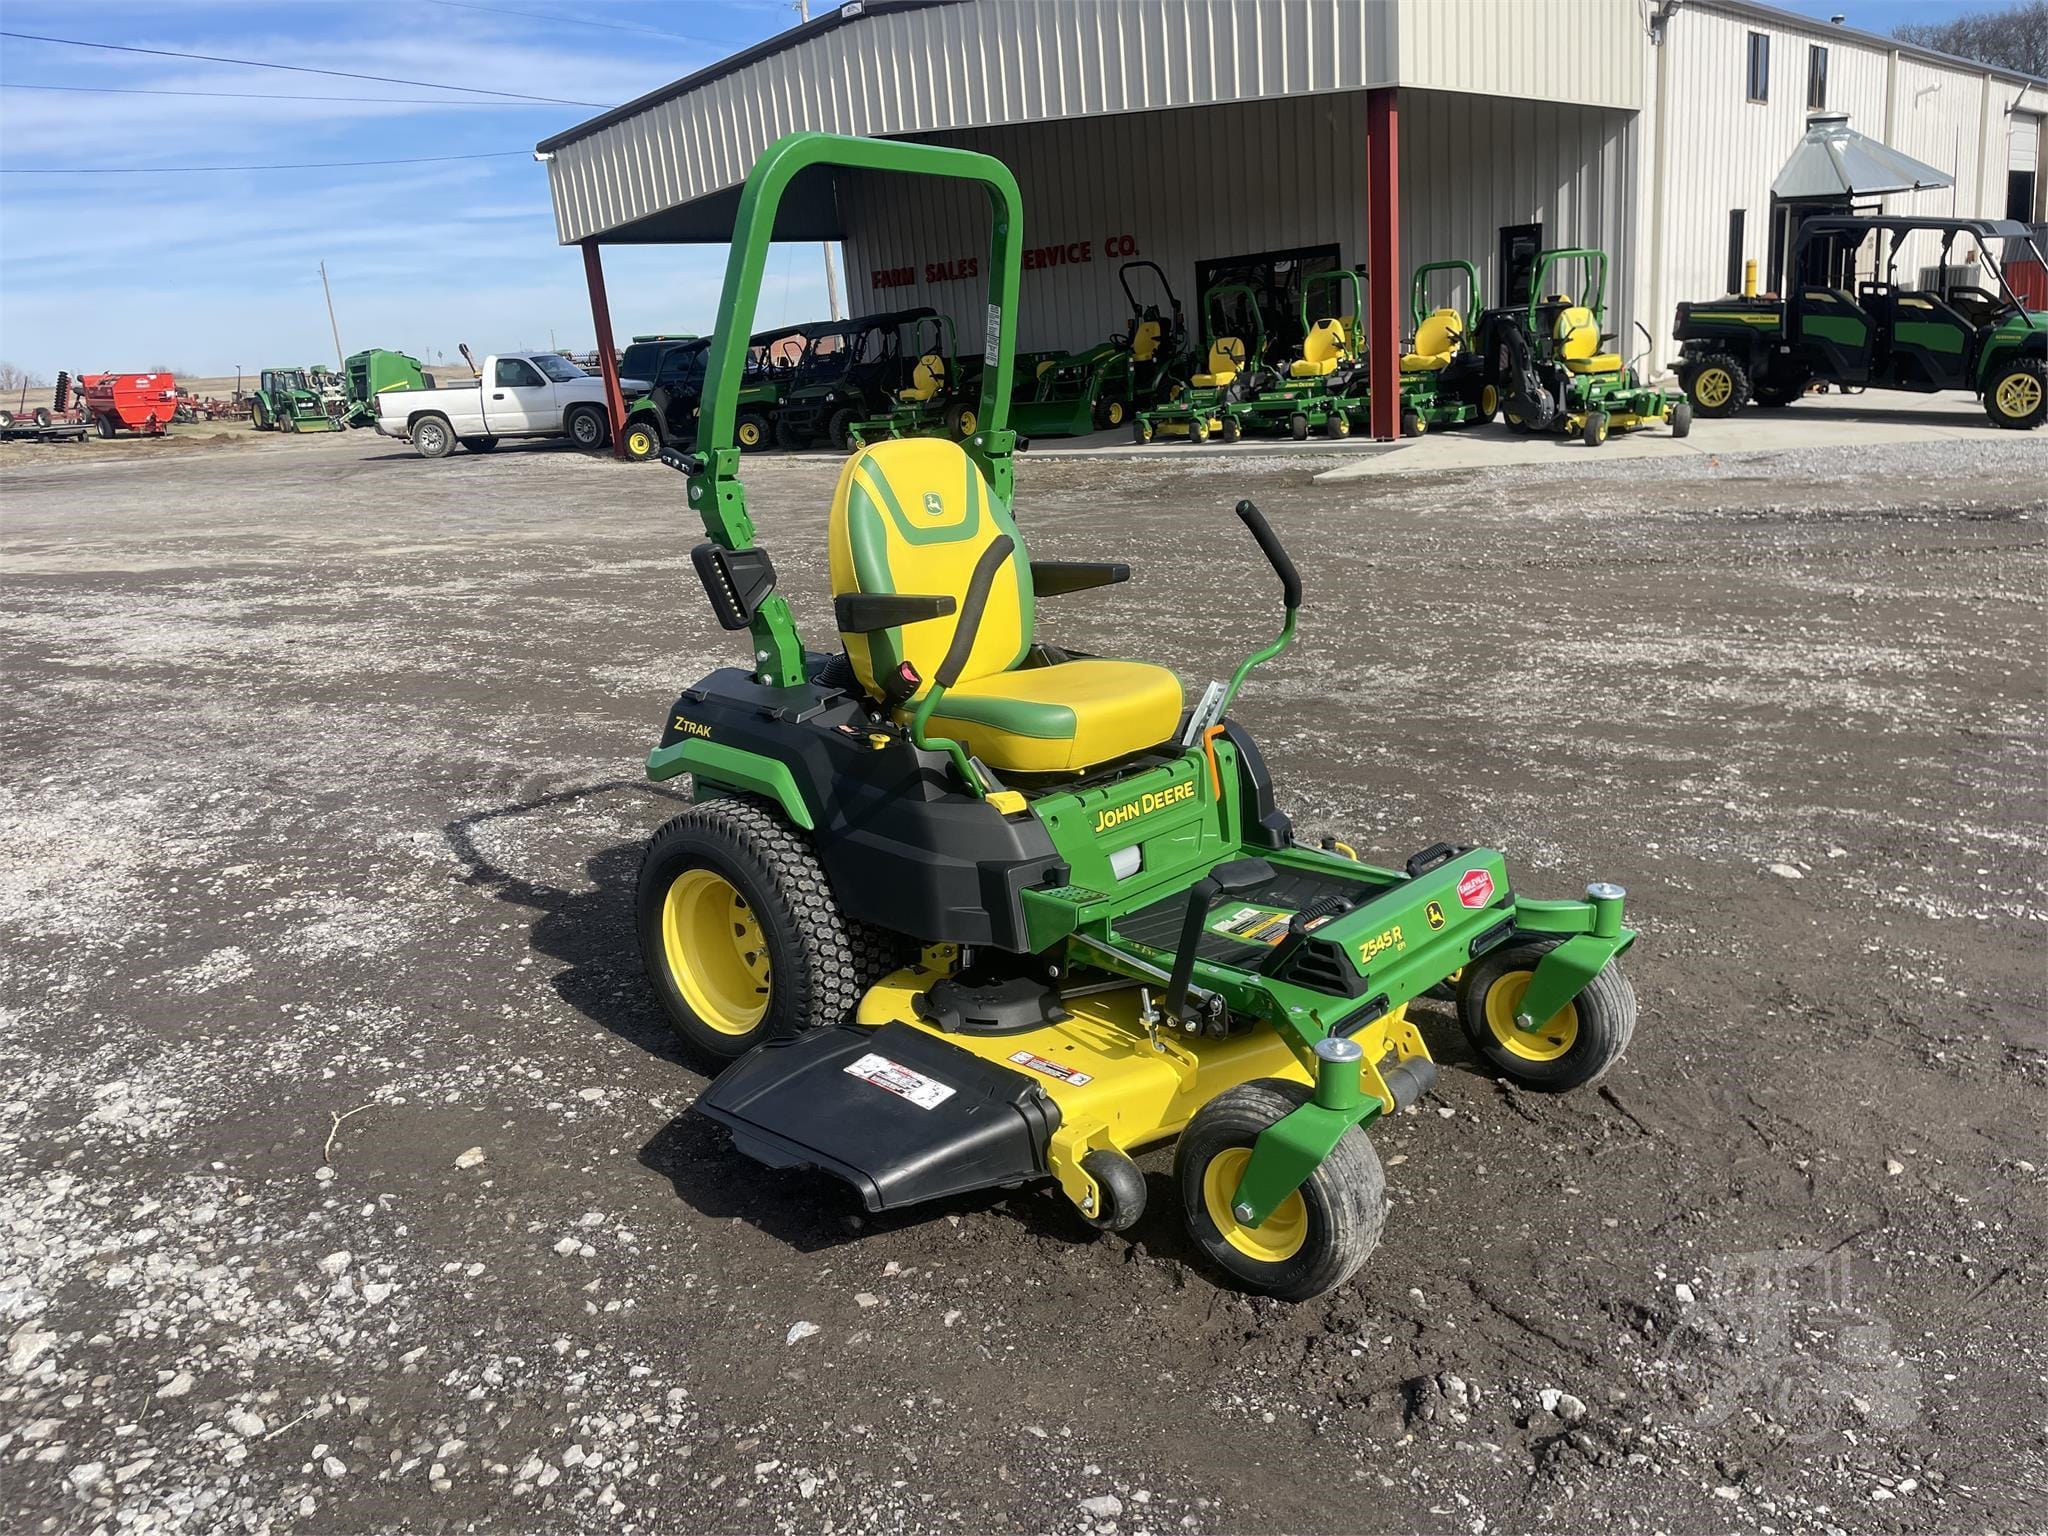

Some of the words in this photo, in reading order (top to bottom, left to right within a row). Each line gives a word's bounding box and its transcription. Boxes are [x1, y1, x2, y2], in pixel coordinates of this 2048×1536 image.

[871, 267, 915, 289] FARM
[925, 258, 978, 283] SALES
[1022, 241, 1092, 270] ERVICE
[1105, 234, 1140, 258] CO.
[673, 715, 712, 738] ZTRAK
[1095, 800, 1140, 833] JOHN
[1141, 780, 1195, 814] DEERE
[1460, 872, 1489, 895] EAGLEVILLE
